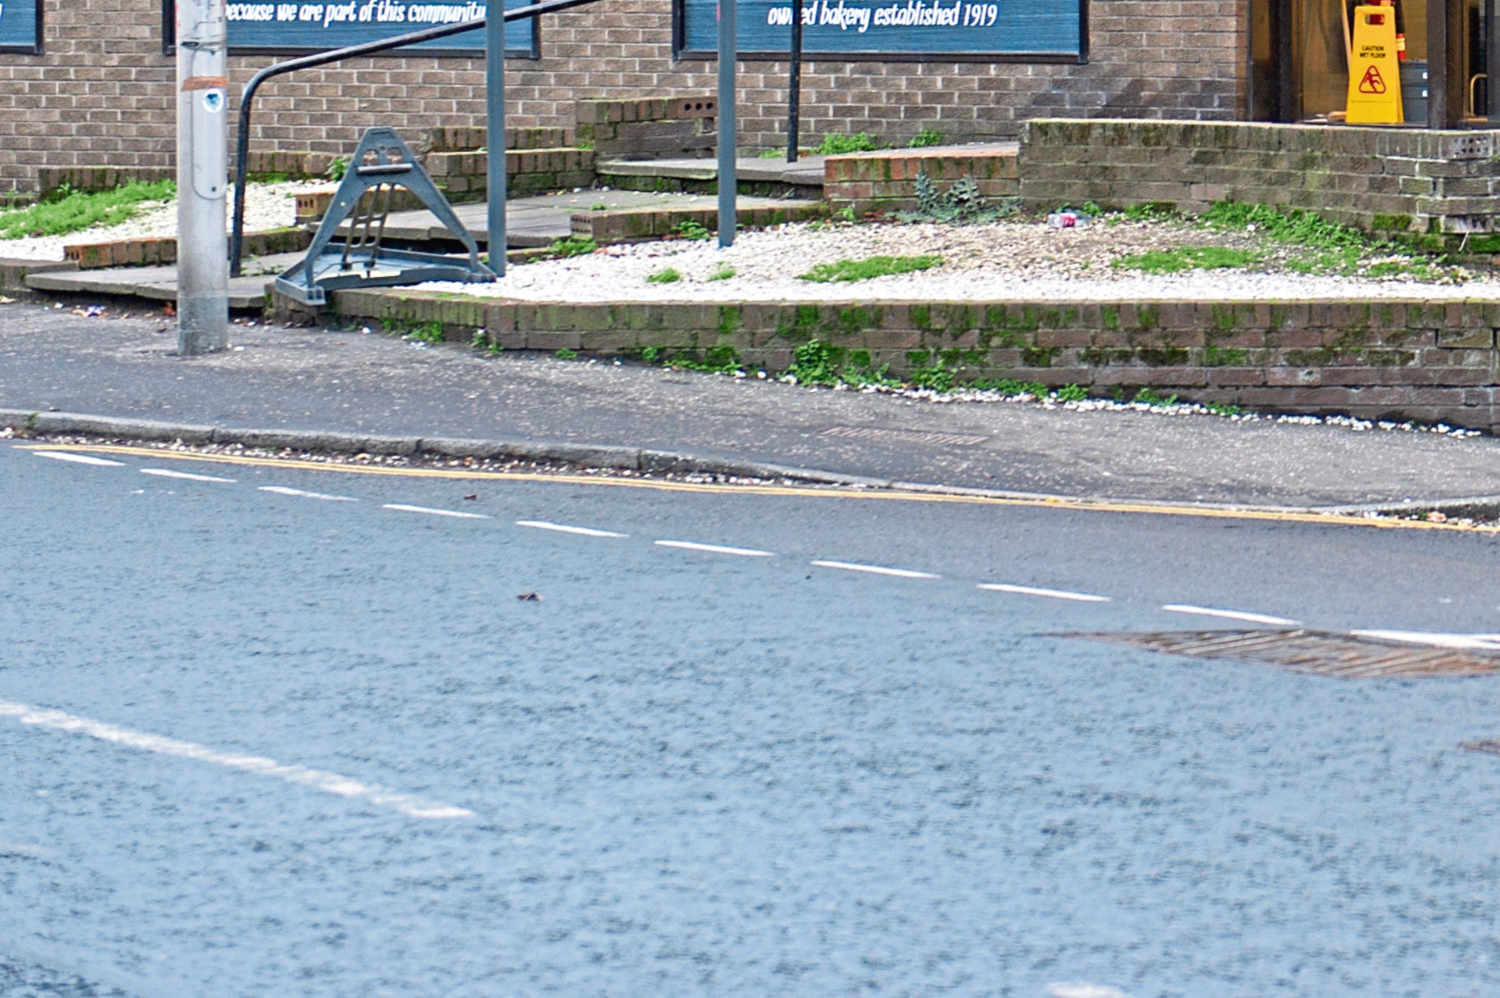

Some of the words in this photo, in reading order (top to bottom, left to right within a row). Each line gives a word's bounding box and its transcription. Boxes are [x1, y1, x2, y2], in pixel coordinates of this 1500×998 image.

[277, 4, 297, 22] we
[299, 4, 322, 22] are
[323, 1, 356, 28] part
[819, 0, 872, 34] bakery
[873, 0, 962, 26] established
[962, 3, 998, 27] 1919
